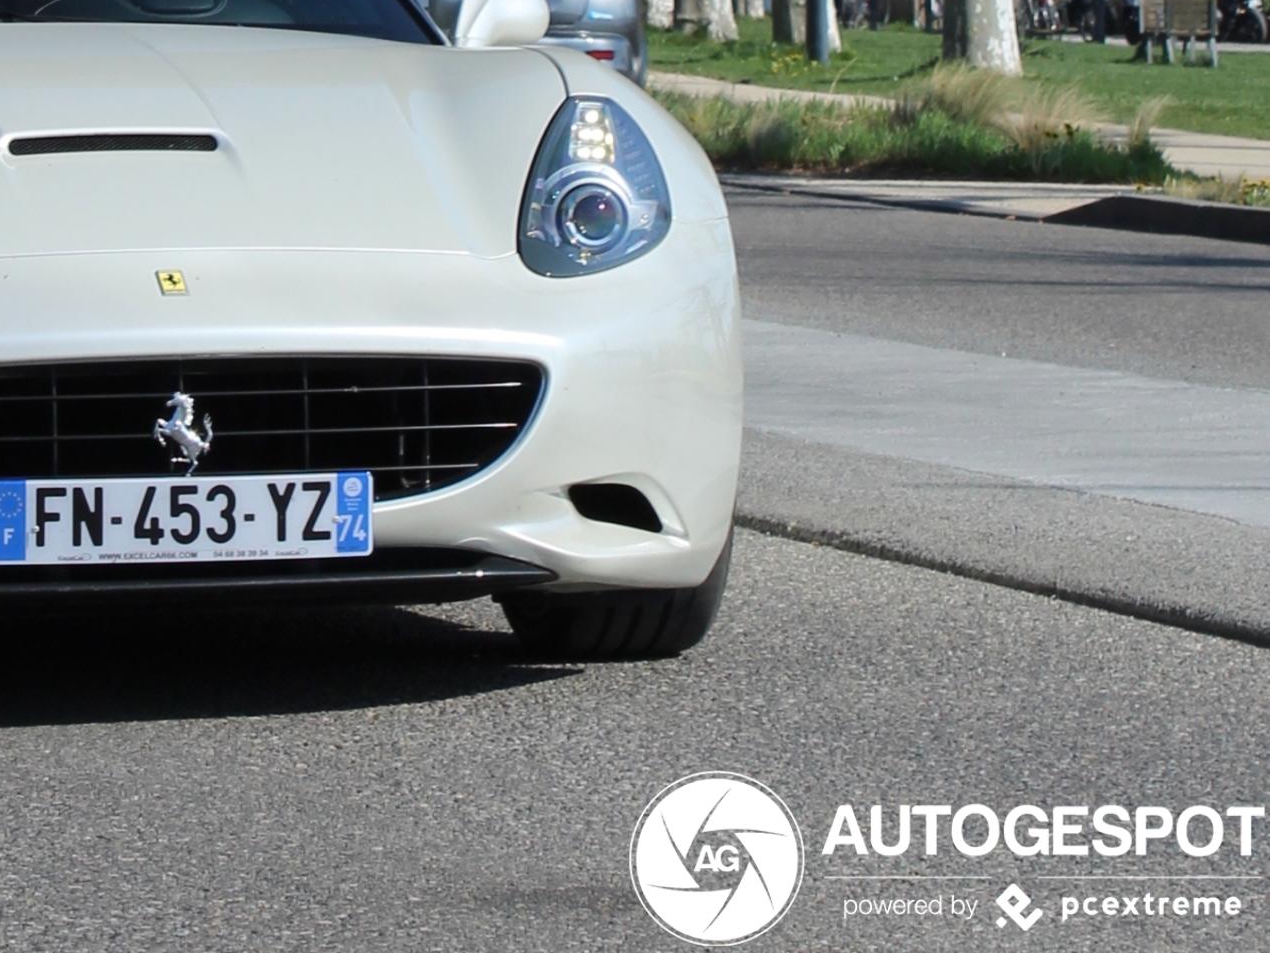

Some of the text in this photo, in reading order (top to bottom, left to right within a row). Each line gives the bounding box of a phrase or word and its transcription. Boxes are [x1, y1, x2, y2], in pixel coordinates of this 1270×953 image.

[35, 481, 331, 547] FN-453-YZ
[338, 514, 367, 542] 74
[3, 528, 15, 545] F
